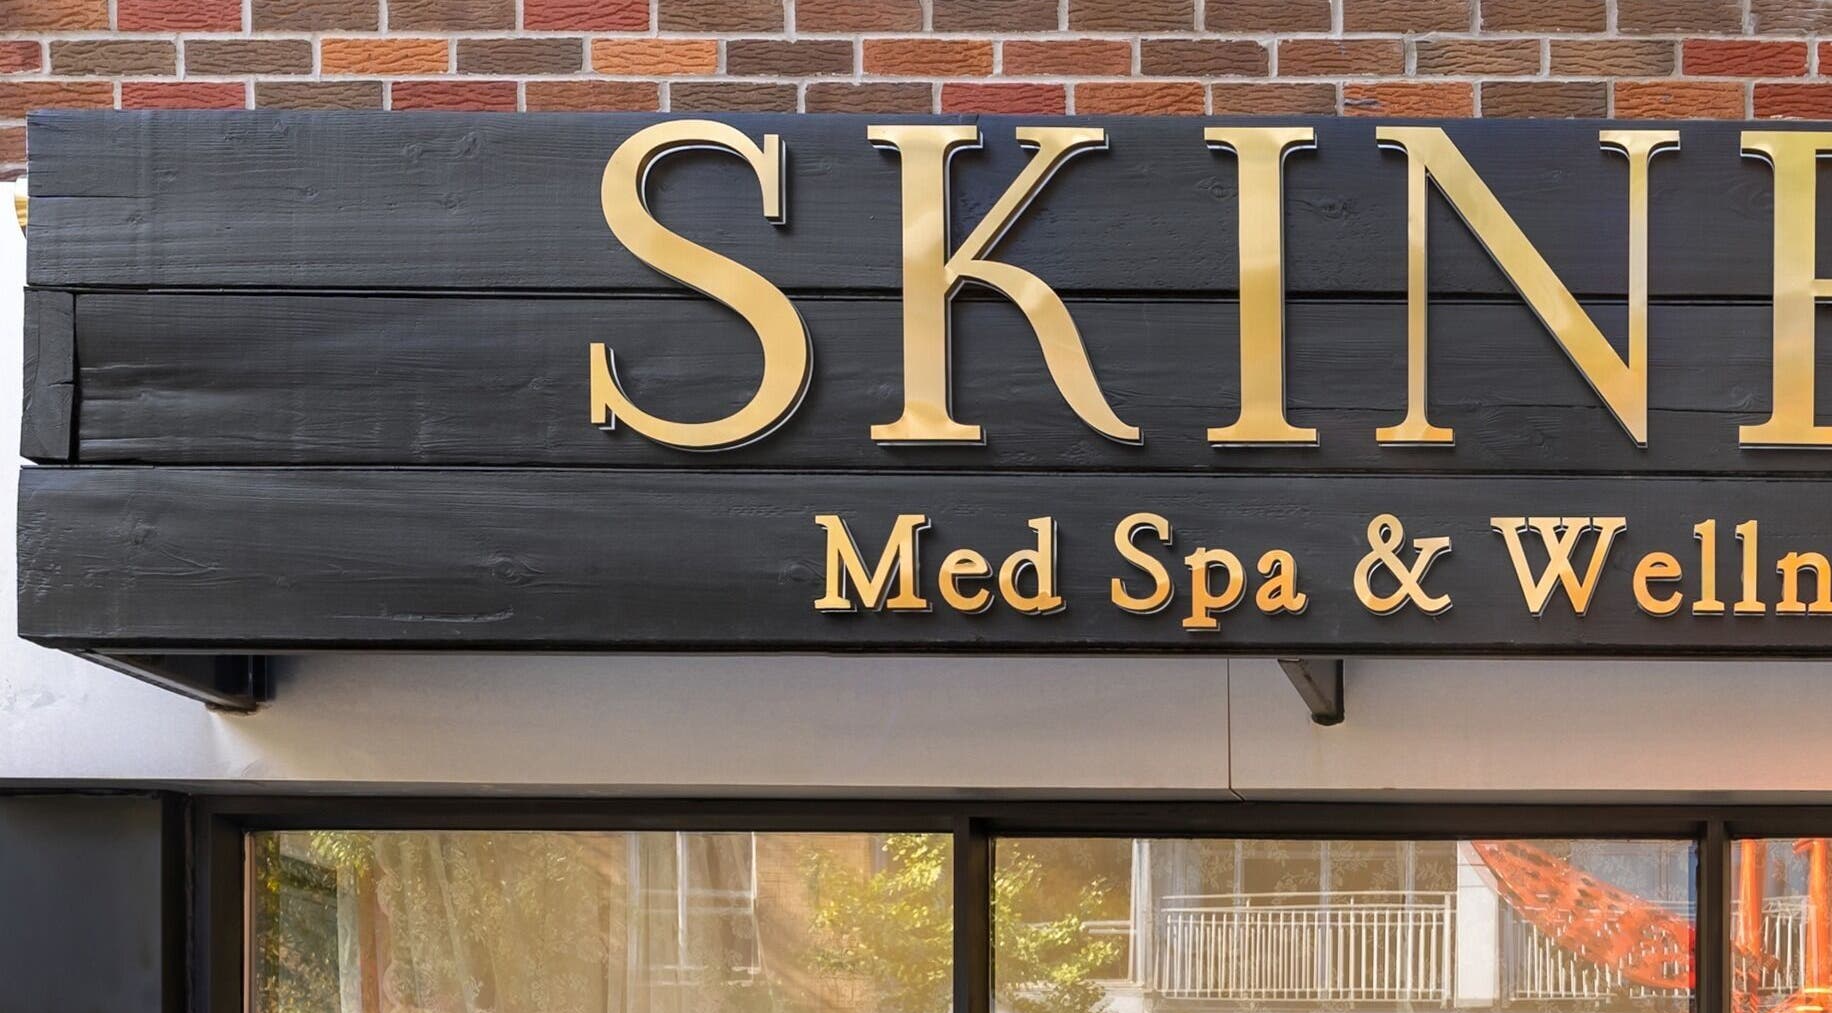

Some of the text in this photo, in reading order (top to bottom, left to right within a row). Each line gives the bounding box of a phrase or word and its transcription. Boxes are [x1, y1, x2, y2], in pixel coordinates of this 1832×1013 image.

[813, 513, 1066, 615] Med
[1111, 512, 1310, 632] Spa
[1353, 513, 1453, 617] &
